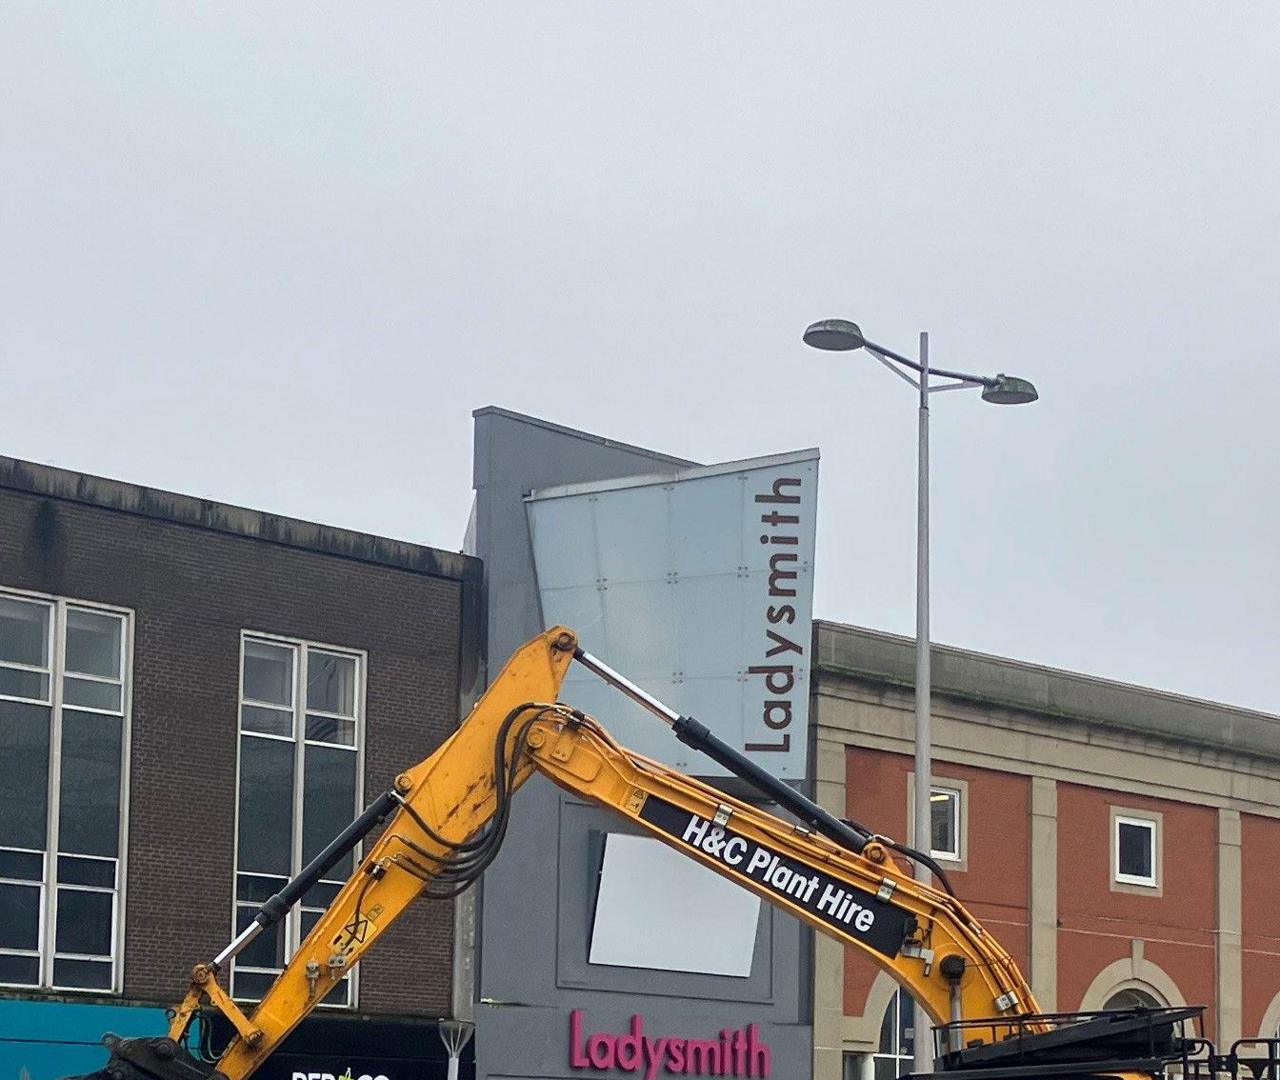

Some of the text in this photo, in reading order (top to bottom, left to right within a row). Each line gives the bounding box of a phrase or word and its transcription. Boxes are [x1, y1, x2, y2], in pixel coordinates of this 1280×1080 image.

[745, 478, 803, 752] Ladysmith
[682, 815, 875, 932] H&C Plant Hire
